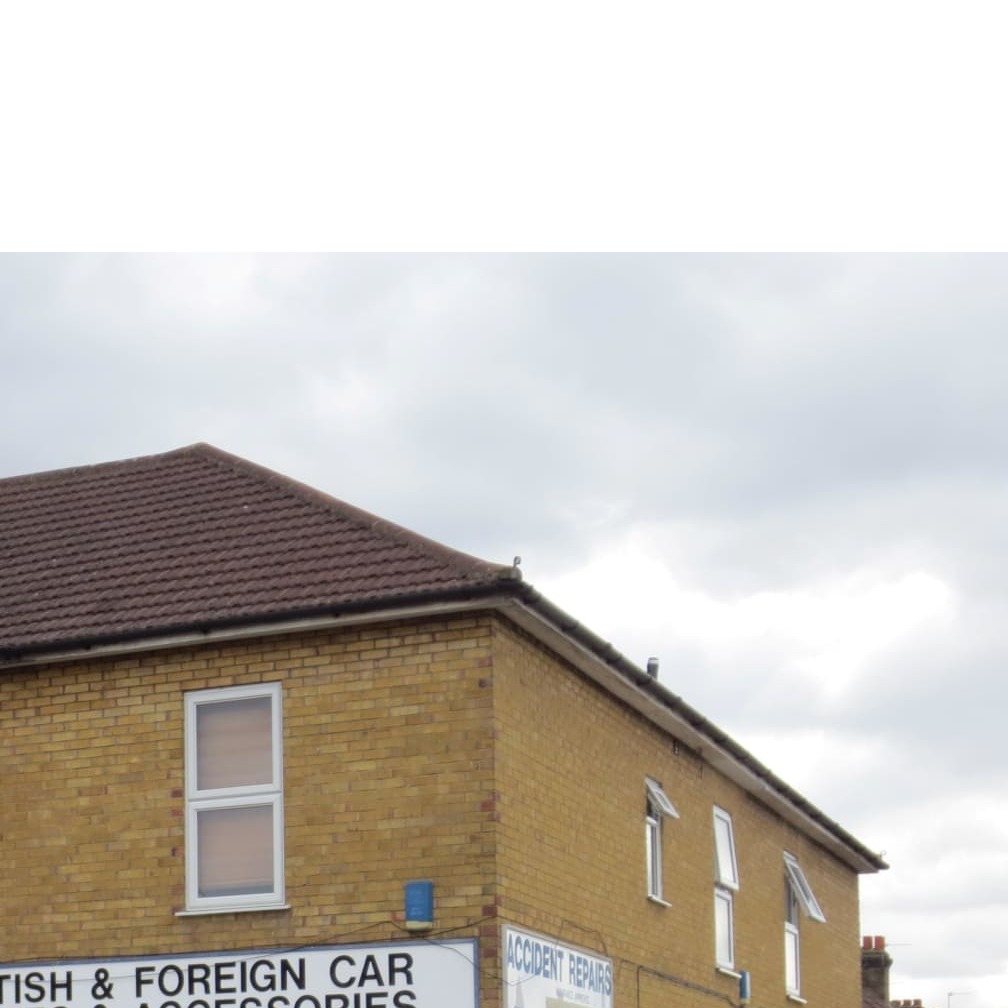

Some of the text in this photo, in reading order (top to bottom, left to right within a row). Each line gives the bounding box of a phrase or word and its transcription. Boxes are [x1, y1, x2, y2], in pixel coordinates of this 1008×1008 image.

[91, 968, 114, 999] &
[135, 958, 306, 998] FOREIGN
[329, 953, 414, 989] CAR
[507, 933, 612, 996] ACCIDENT REPAIRS
